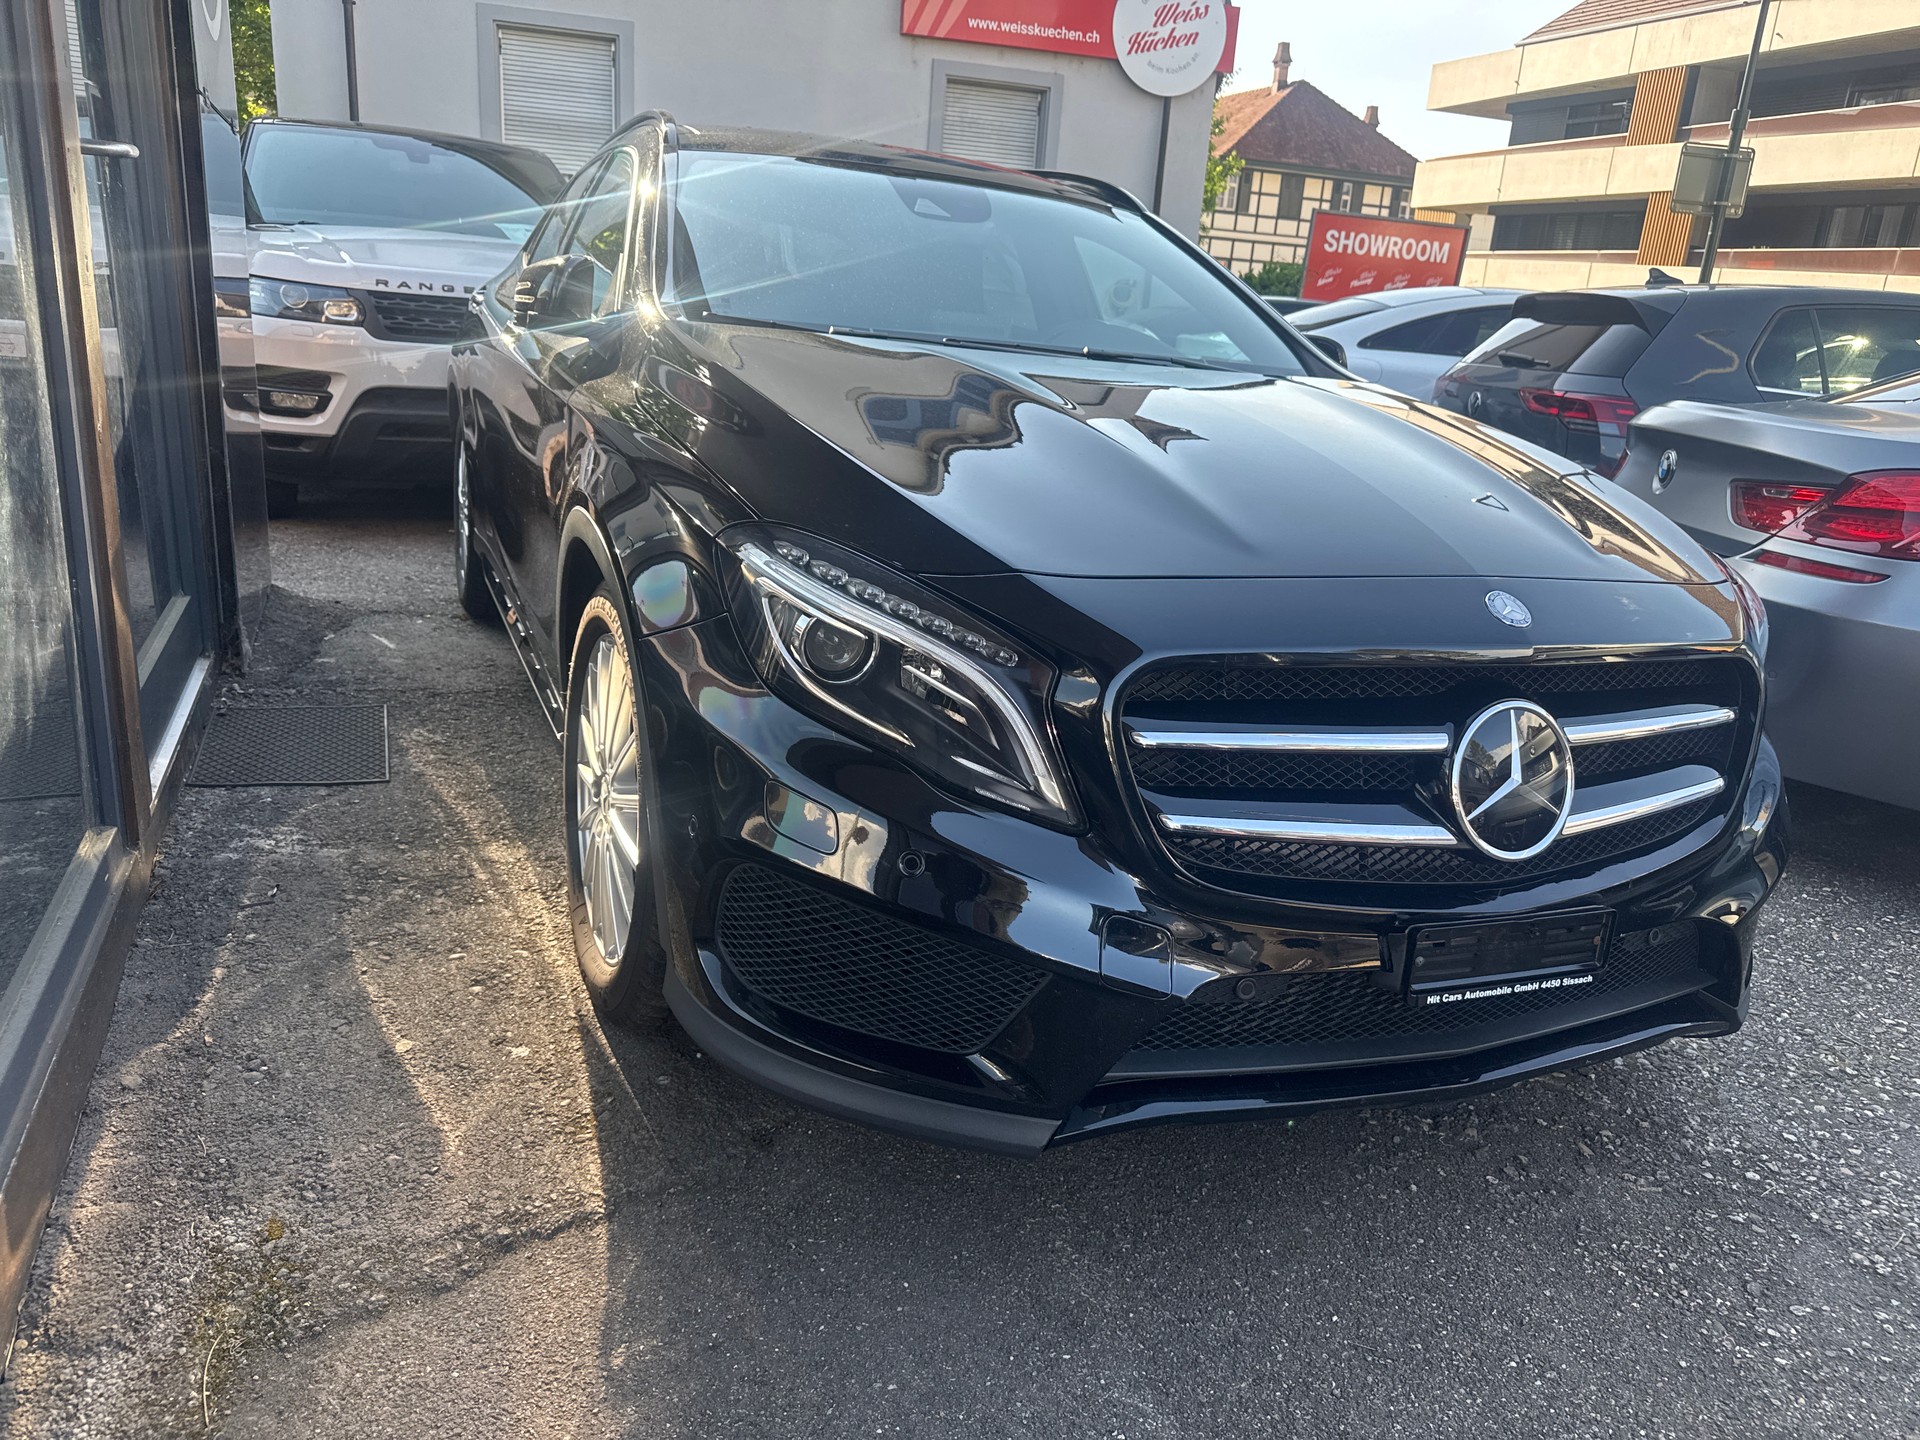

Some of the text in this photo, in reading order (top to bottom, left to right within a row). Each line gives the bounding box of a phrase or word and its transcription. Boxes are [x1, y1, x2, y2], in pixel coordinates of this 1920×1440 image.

[1153, 1, 1210, 28] Weiss
[967, 17, 1100, 44] www.weisskuechen.ch
[1127, 27, 1200, 56] Küchen
[1323, 229, 1450, 264] SHOWROOM
[375, 279, 475, 294] RANGE
[1426, 974, 1593, 1004] Hit Cars Automobile GmbH 4450 Sissach
